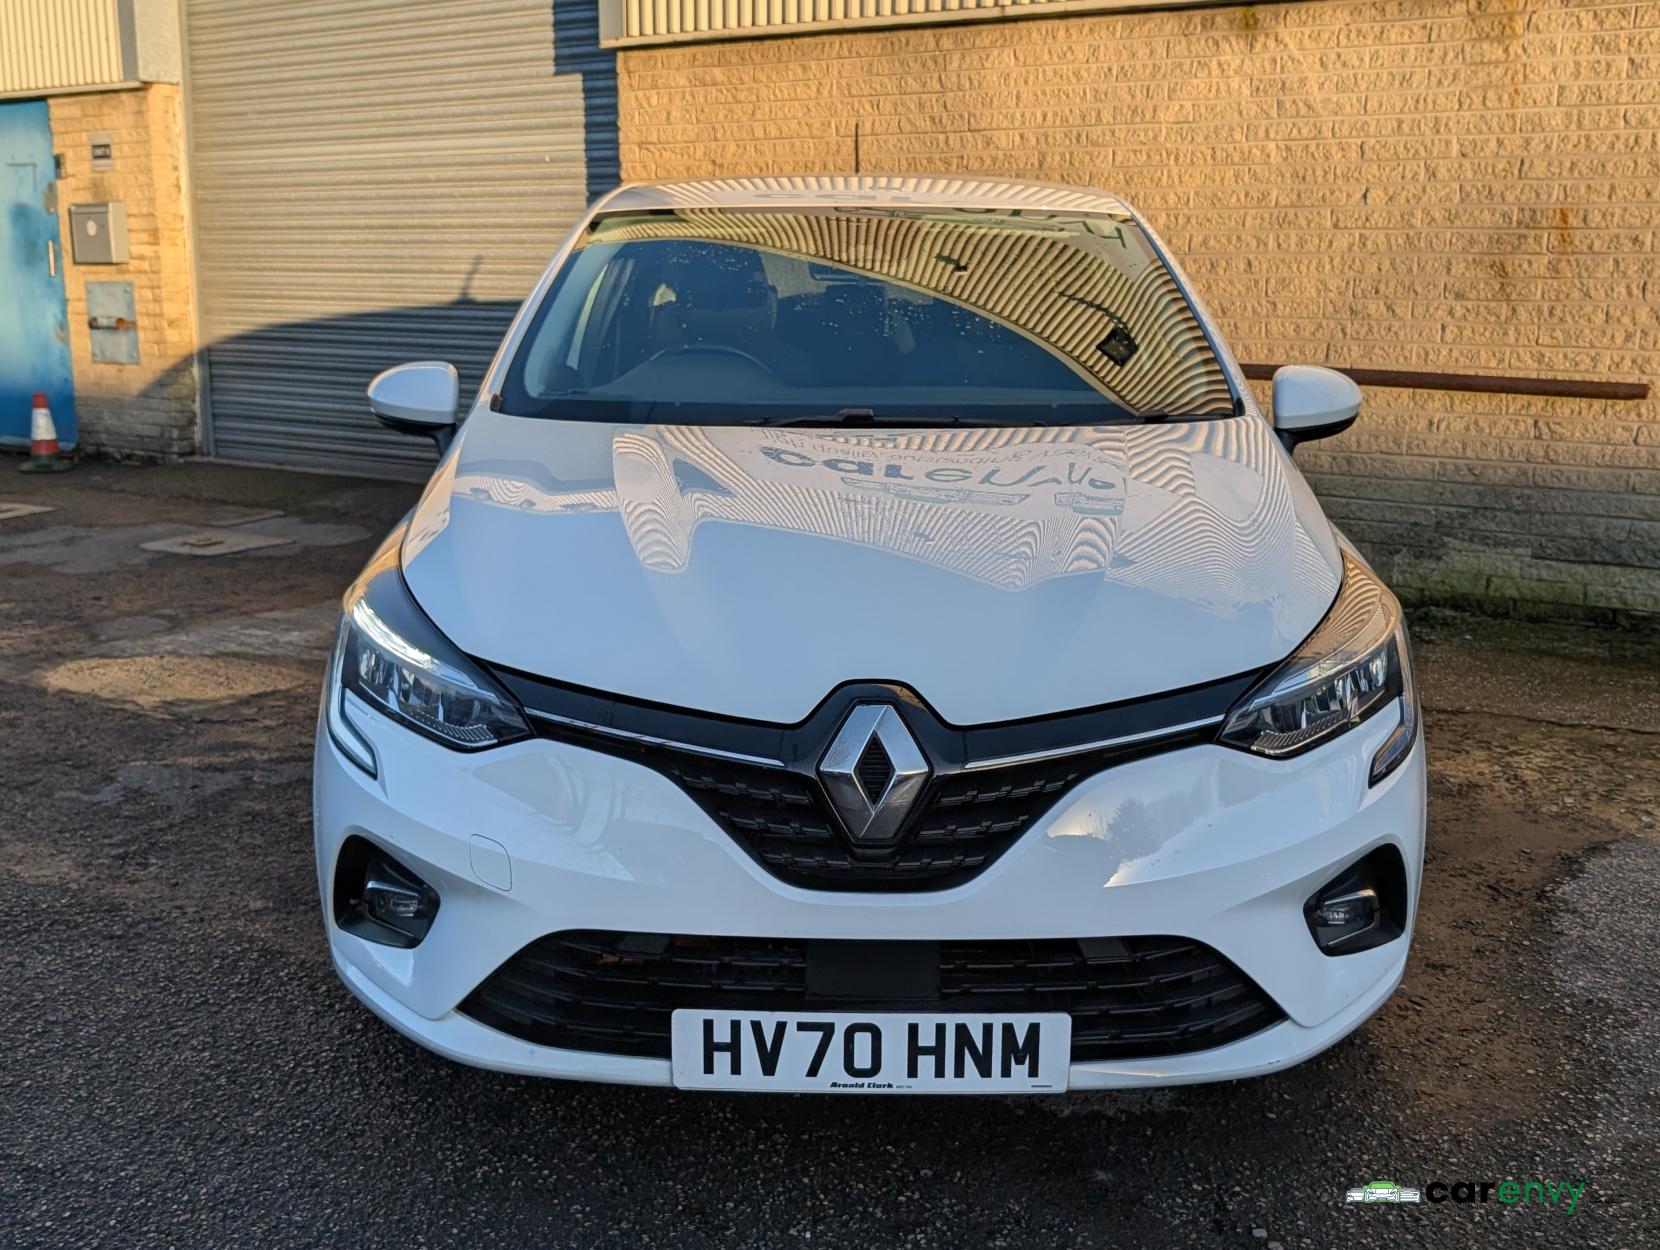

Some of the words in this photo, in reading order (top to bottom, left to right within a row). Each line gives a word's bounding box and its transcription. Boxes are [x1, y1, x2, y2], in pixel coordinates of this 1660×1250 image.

[702, 1018, 883, 1079] HV70
[907, 1022, 1041, 1079] HNM
[830, 1081, 865, 1089] Arnold
